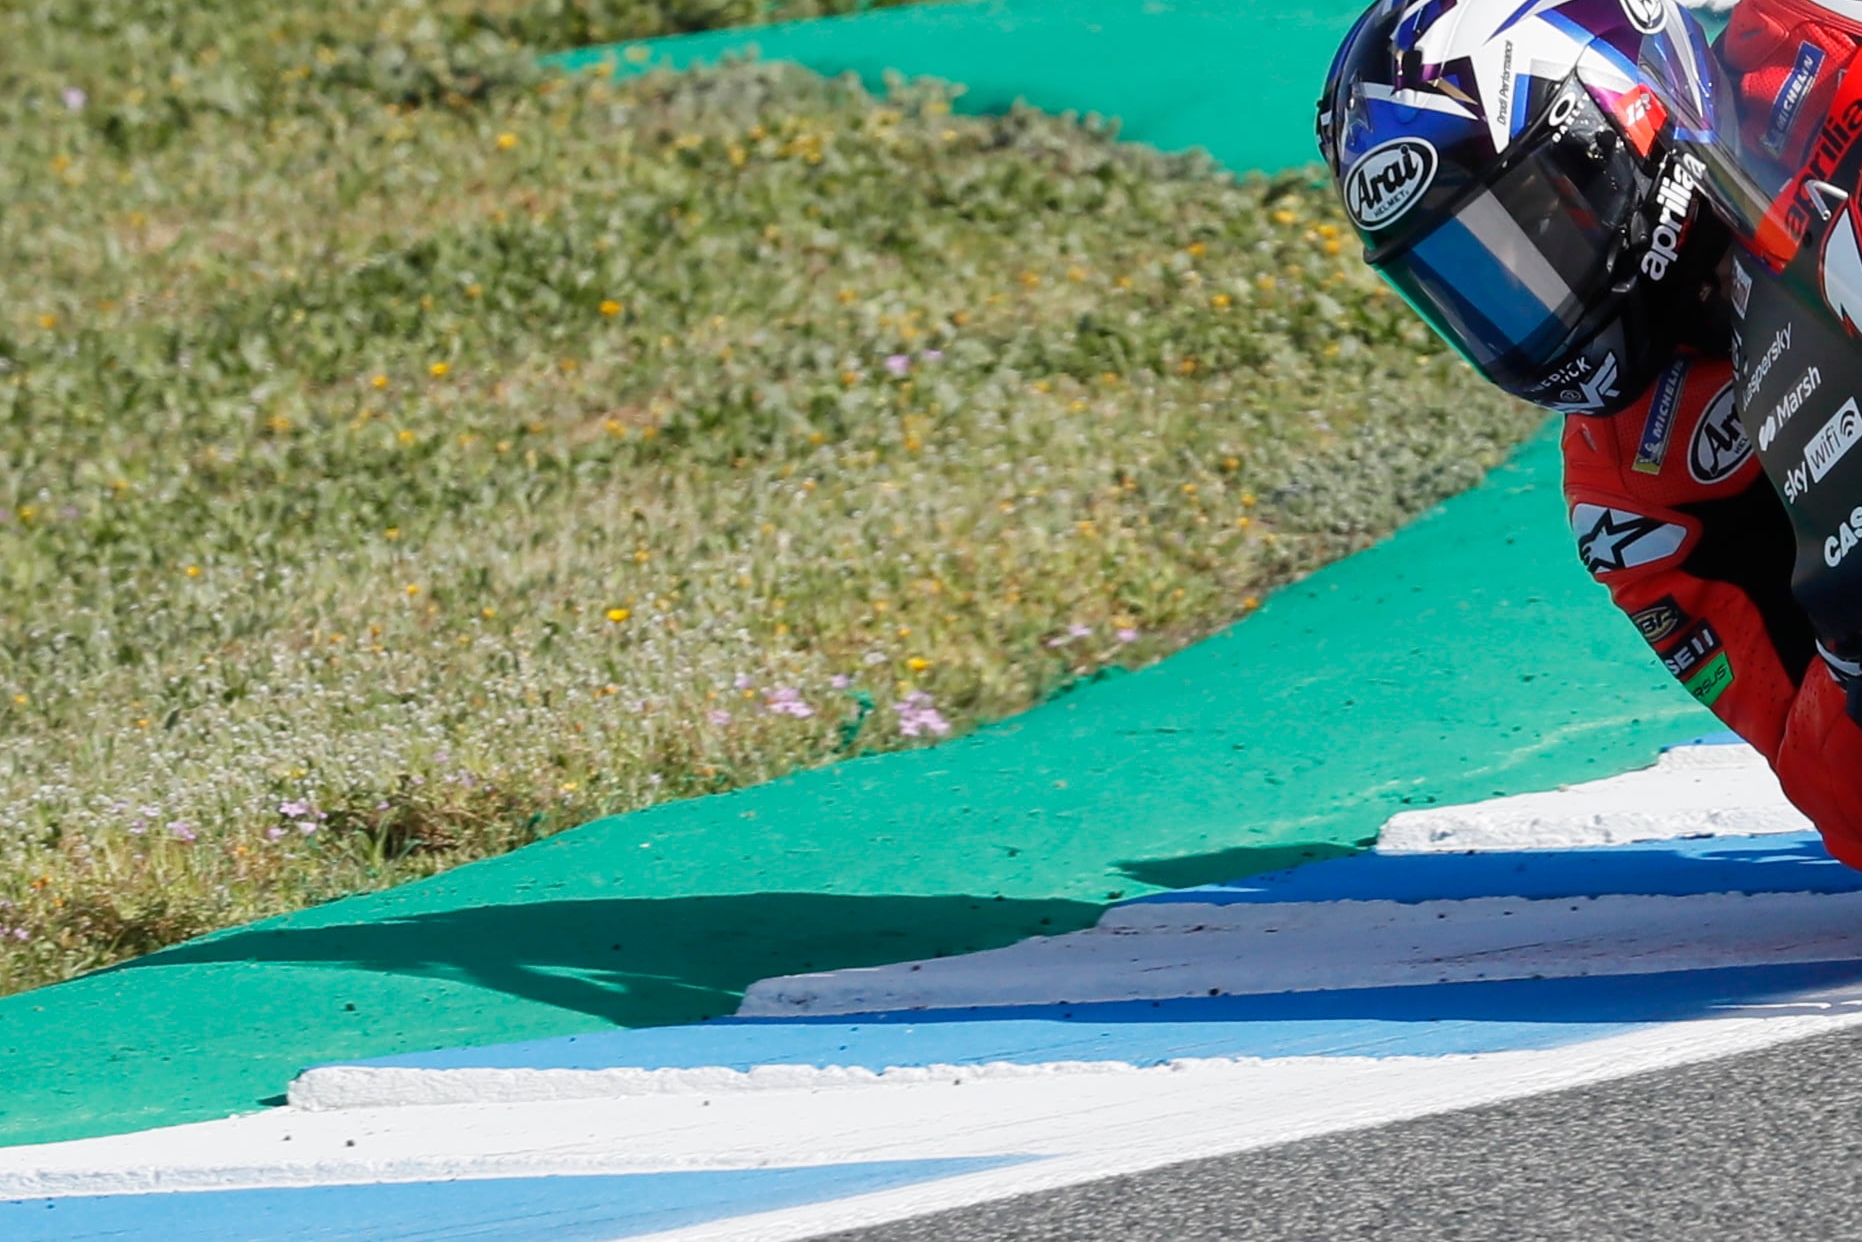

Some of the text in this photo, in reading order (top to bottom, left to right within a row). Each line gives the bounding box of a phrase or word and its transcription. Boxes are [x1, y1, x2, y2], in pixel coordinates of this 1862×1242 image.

[1776, 55, 1814, 130] MICHELIN
[1356, 145, 1419, 220] Arai
[1641, 151, 1707, 282] aprilia
[1742, 322, 1793, 412] kaspersky
[1775, 366, 1822, 429] Marsh
[1702, 403, 1742, 478] Ar
[1783, 419, 1842, 504] sky wifi
